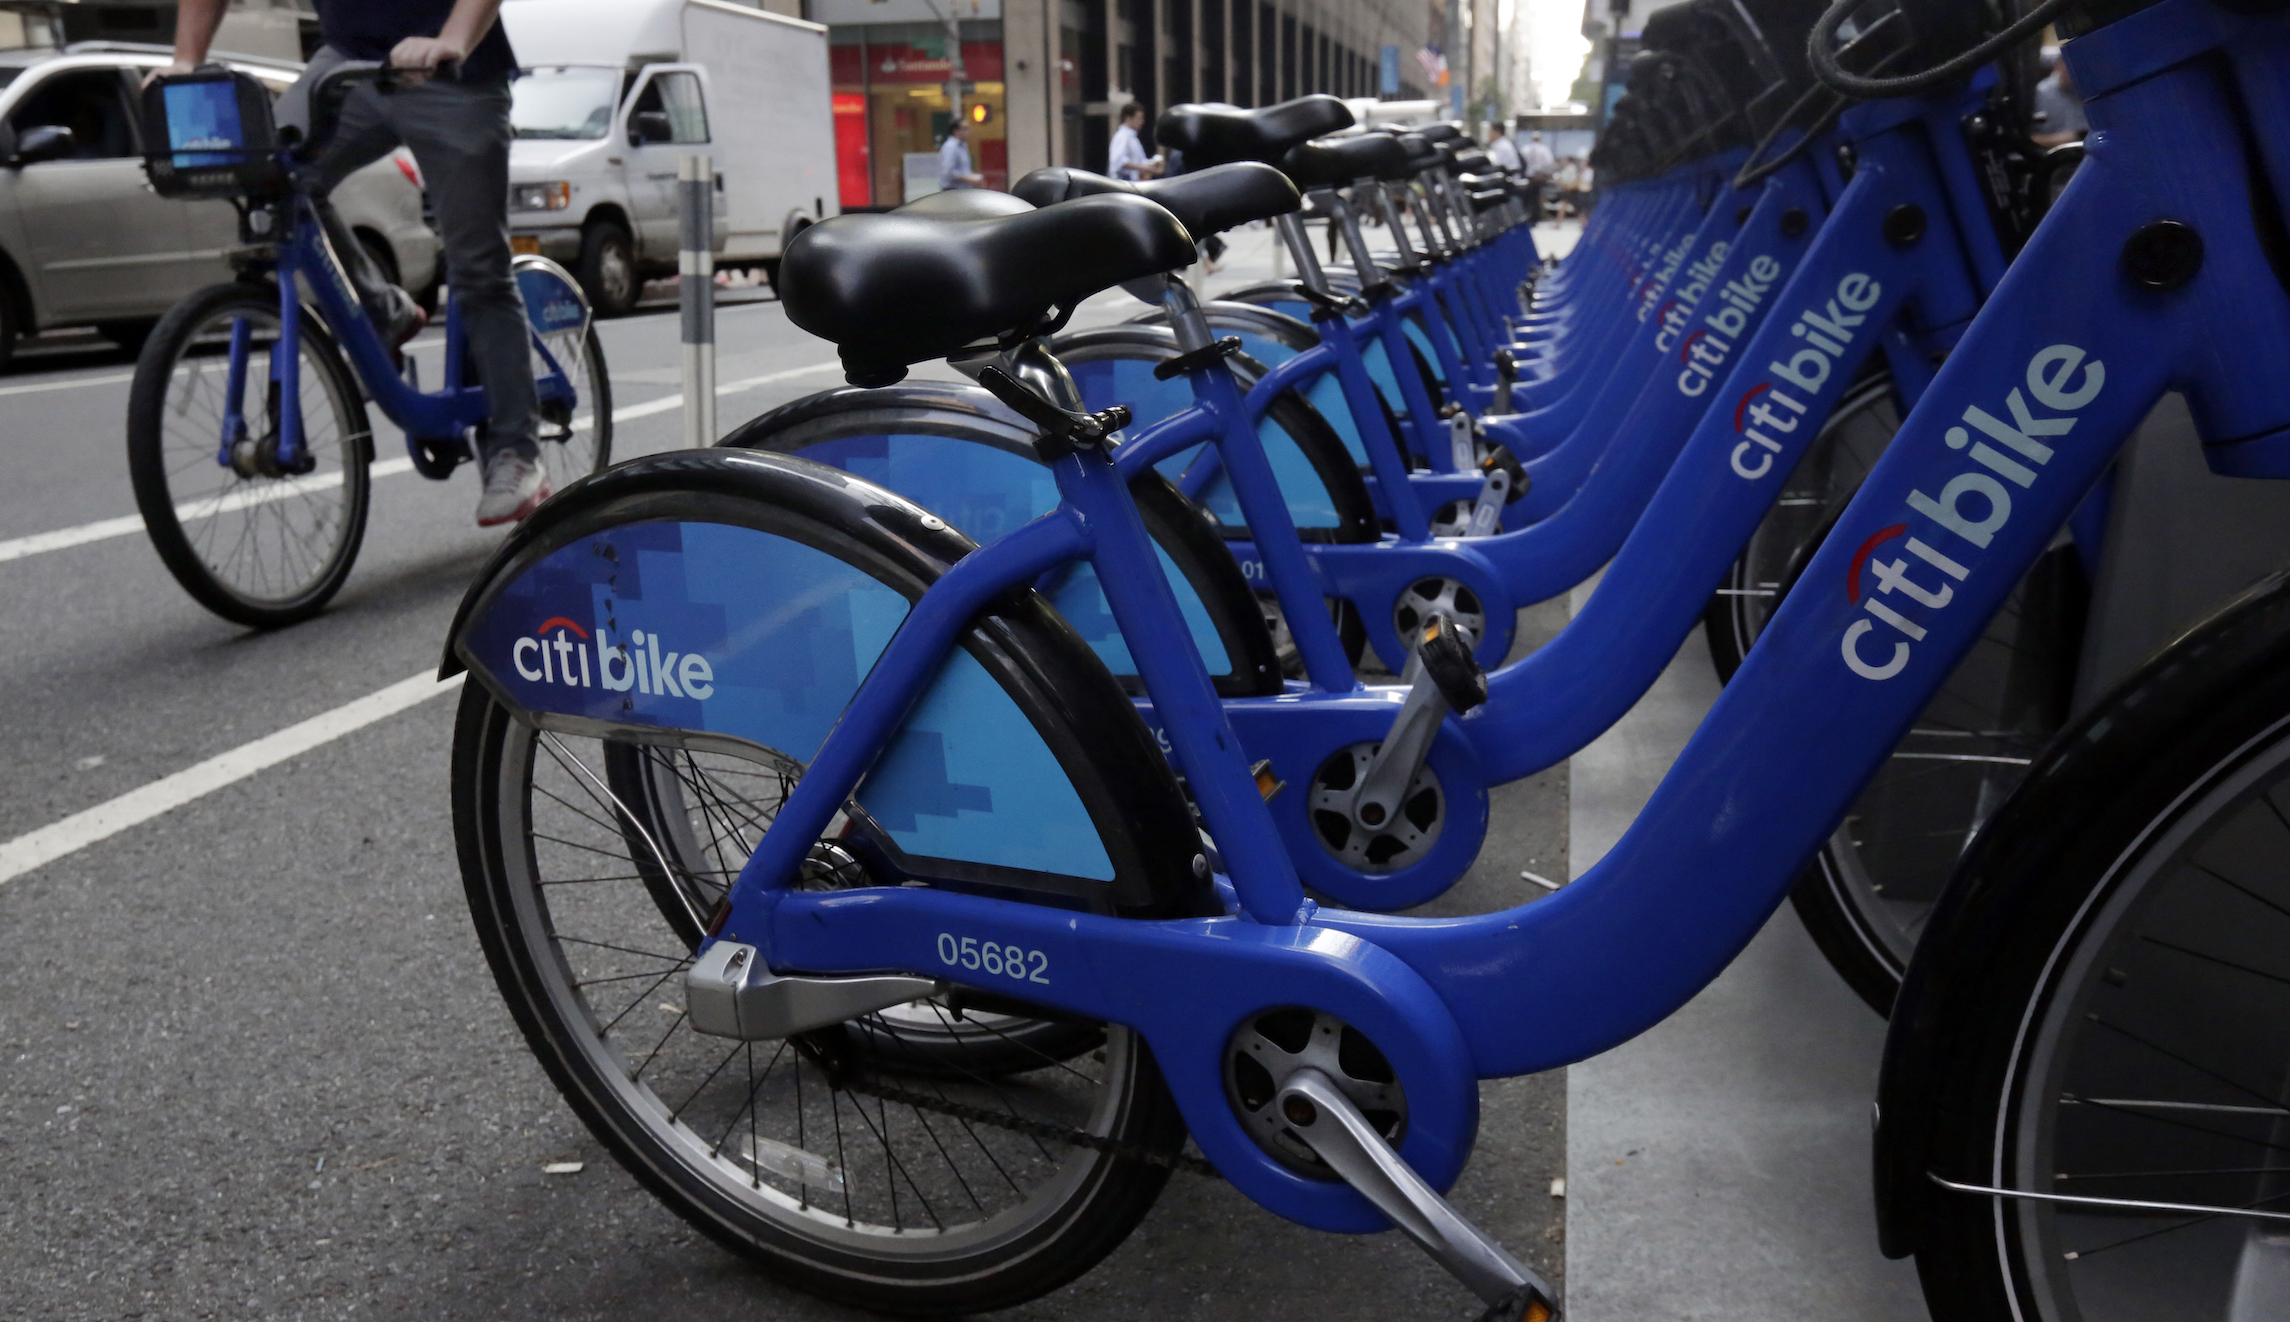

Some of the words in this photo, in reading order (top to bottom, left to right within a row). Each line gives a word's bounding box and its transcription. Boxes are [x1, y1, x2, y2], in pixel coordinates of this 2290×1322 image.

[1675, 241, 1729, 304] bike
[1704, 254, 1780, 339] bike
[1678, 334, 1731, 397] citi
[1768, 272, 1882, 395] bike
[1730, 388, 1808, 480] citi
[1905, 343, 2106, 549] bike
[1841, 535, 1971, 681] citi
[513, 628, 591, 688] citi
[596, 628, 714, 700] bike
[937, 932, 1050, 985] 05682
